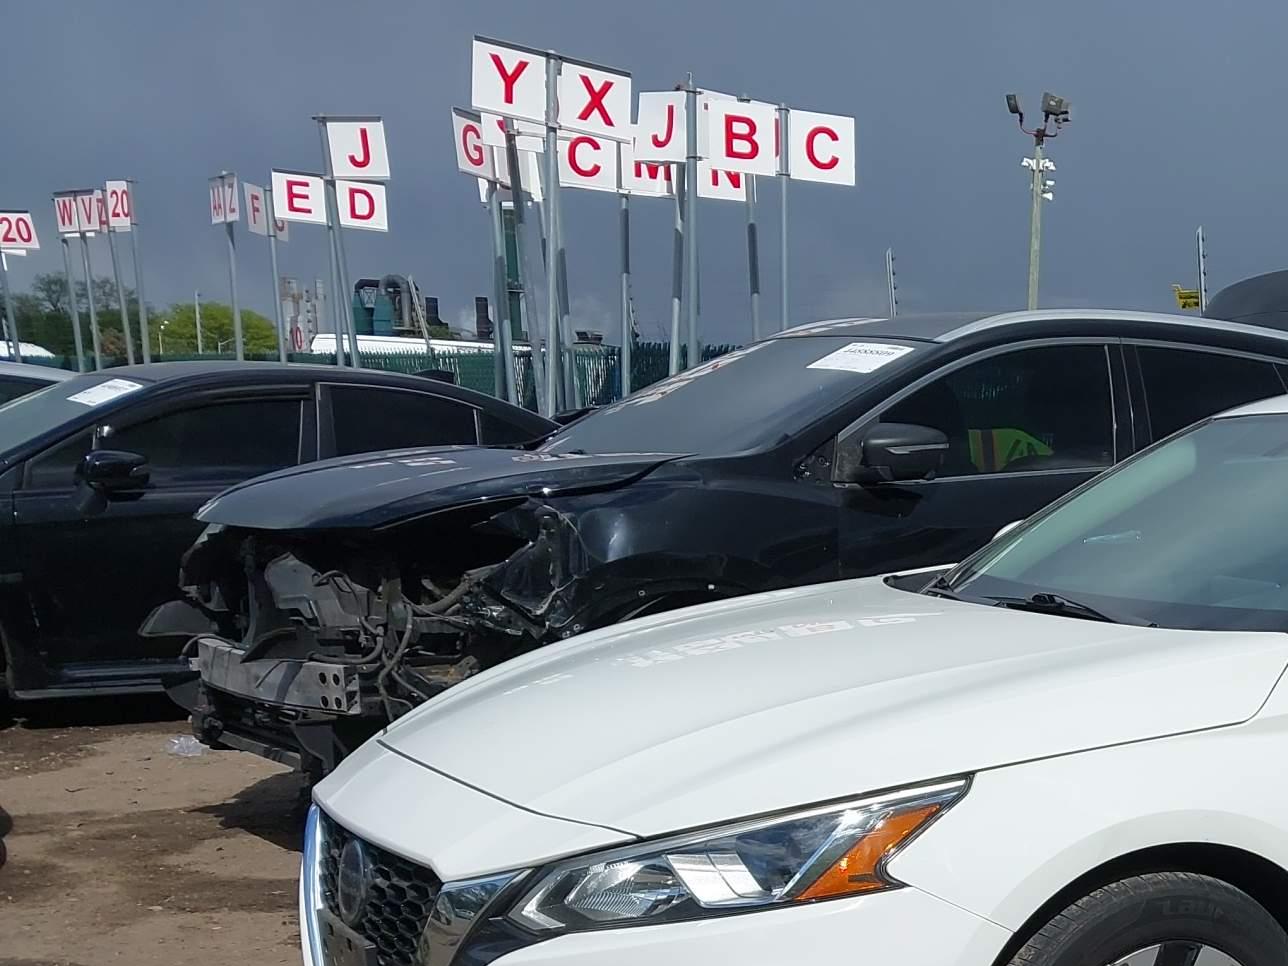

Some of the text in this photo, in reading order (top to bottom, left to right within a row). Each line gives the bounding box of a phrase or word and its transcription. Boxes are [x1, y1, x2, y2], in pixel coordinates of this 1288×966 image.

[490, 53, 529, 104] Y
[578, 74, 614, 127] X
[462, 124, 484, 166] G
[651, 104, 674, 148] J
[724, 114, 759, 160] B
[348, 128, 371, 169] J
[568, 136, 601, 177] C
[805, 127, 839, 170] C
[57, 199, 72, 226] W
[81, 197, 92, 225] V
[110, 190, 130, 217] 20
[250, 193, 260, 224] F
[286, 180, 312, 214] E
[349, 187, 375, 220] D
[0, 217, 32, 242] 20
